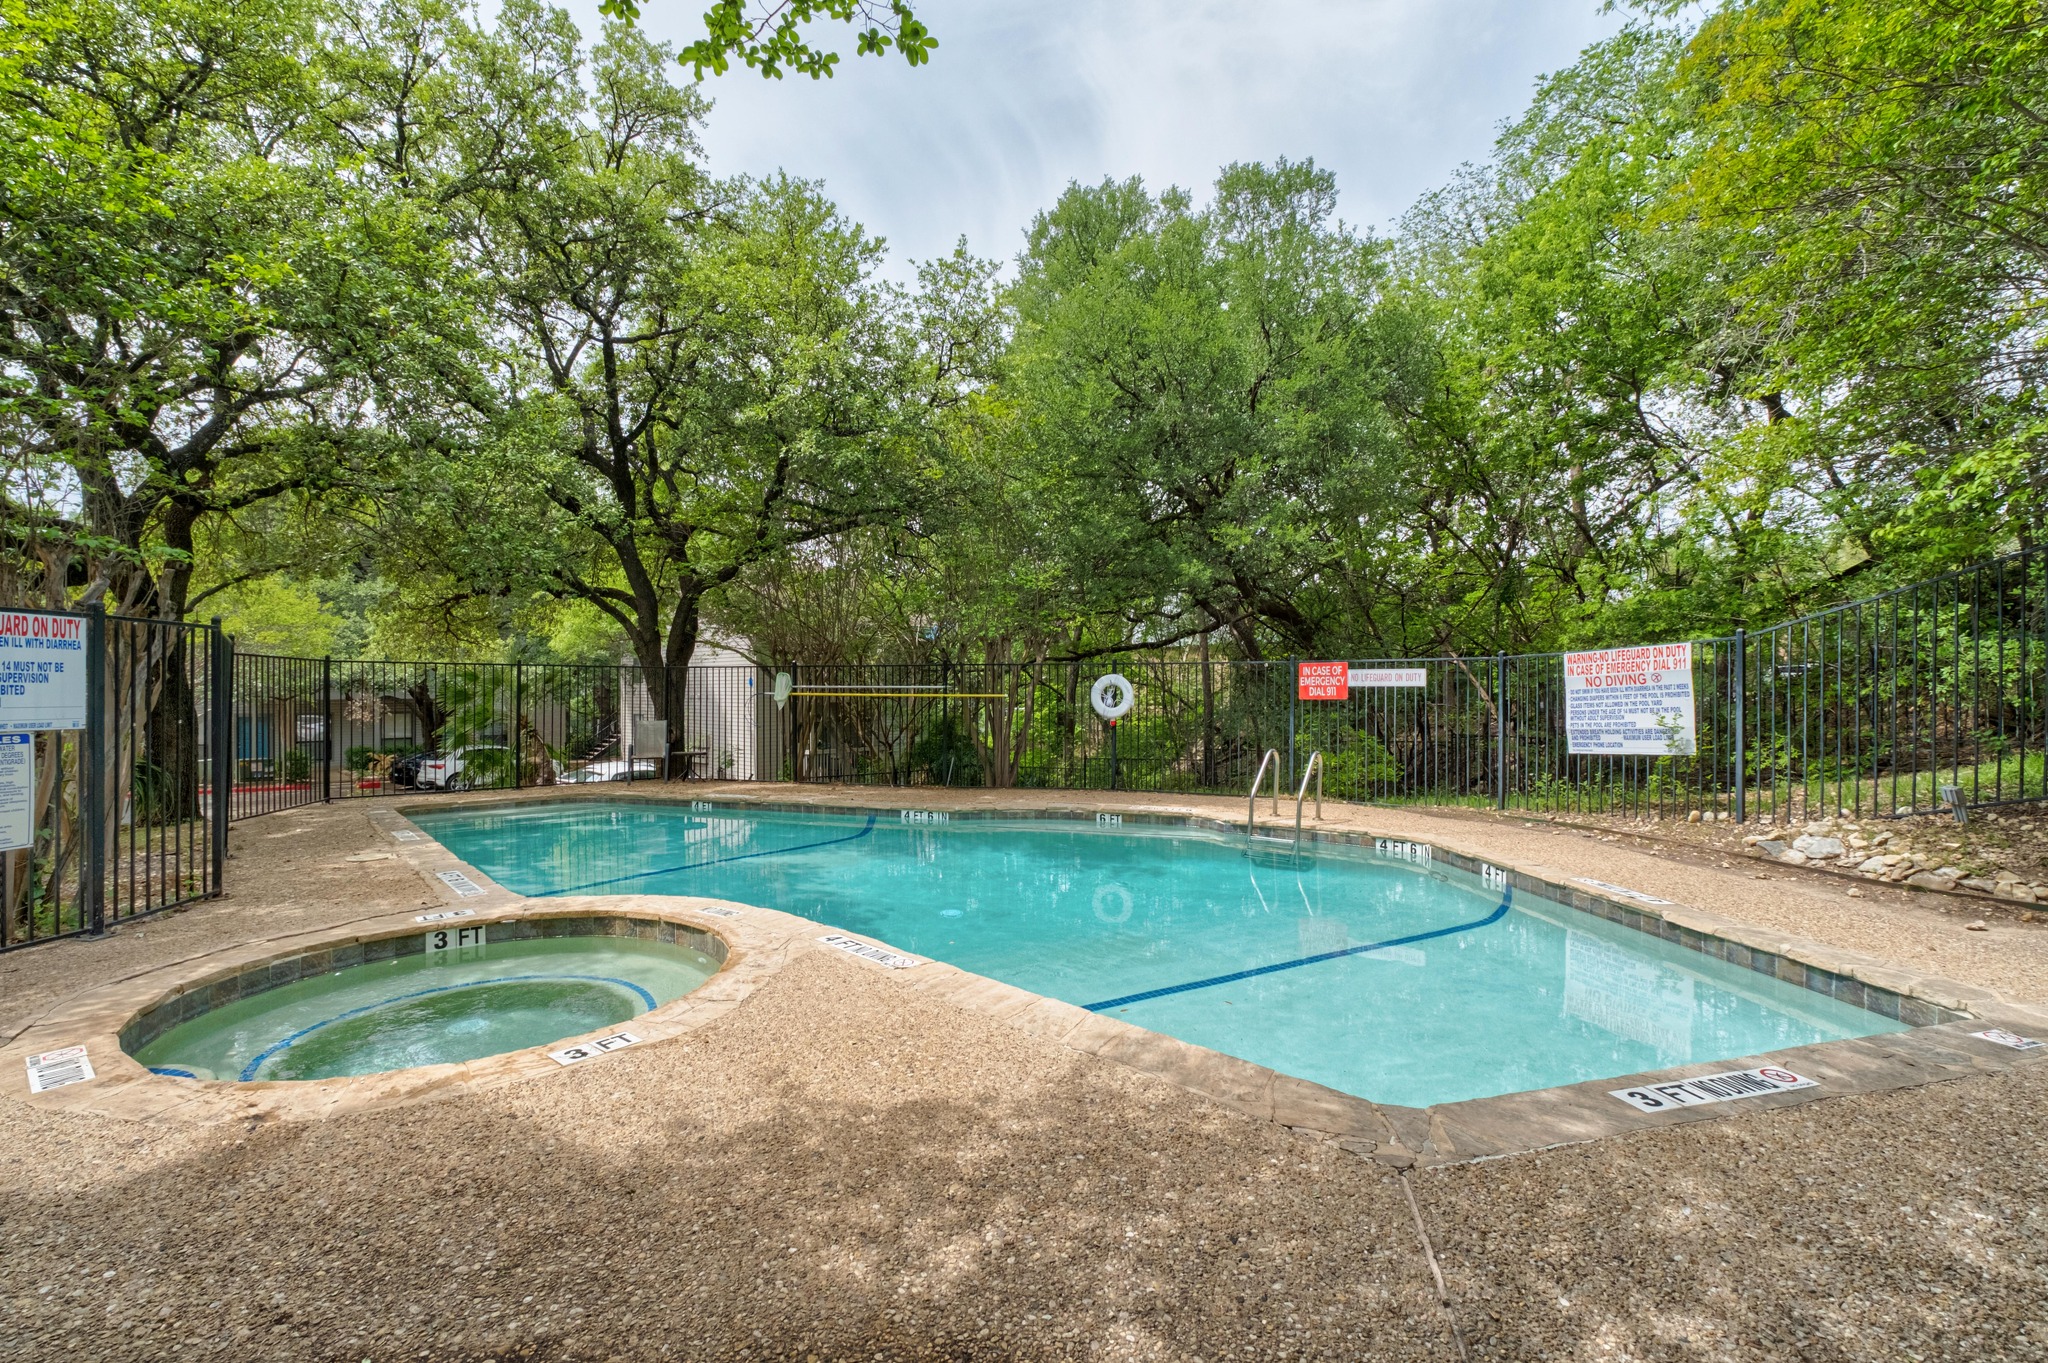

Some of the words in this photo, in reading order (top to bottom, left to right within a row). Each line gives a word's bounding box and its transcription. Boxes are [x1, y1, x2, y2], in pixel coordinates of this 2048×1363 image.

[33, 616, 48, 637] ON
[52, 618, 80, 638] DUTY
[12, 638, 22, 647] ILL
[25, 638, 43, 649] WITH
[46, 639, 81, 650] DIARRHEA
[1567, 652, 1609, 664] WARNING-NO
[1612, 648, 1650, 662] LIFEGUARD
[1653, 647, 1663, 658] ON
[1666, 645, 1686, 657] DUTY
[2, 661, 11, 671] 14
[14, 661, 34, 672] MUST
[38, 662, 52, 672] NOT
[55, 663, 64, 672] BE
[1303, 666, 1310, 675] IN
[1312, 666, 1330, 675] CASE
[1333, 666, 1342, 674] OF
[1568, 666, 1574, 676] IN
[1576, 664, 1593, 676] CASE
[1596, 664, 1604, 674] OF
[1606, 660, 1650, 674] EMERGENCY
[1654, 659, 1670, 670] DIAL
[1673, 658, 1686, 669] 911
[1301, 676, 1344, 686] EMERGENCY
[1406, 673, 1421, 681] DUTY
[1586, 676, 1602, 687] NO
[1606, 673, 1646, 686] DIVING
[1, 685, 25, 695] BITED
[1309, 687, 1325, 696] DIAL
[1327, 687, 1336, 695] 911
[1110, 814, 1120, 822] FT
[1380, 840, 1387, 849] 4
[1393, 841, 1405, 852] FT
[1411, 843, 1416, 854] 6
[1485, 865, 1491, 877] 4
[1496, 868, 1505, 882] FT
[434, 931, 448, 949] 3
[459, 926, 483, 946] FT
[834, 940, 862, 949] FT
[564, 1048, 588, 1059] 3
[596, 1033, 632, 1049] FT
[1687, 1080, 1732, 1097] NO
[1707, 1072, 1779, 1093] DIVING
[1627, 1091, 1664, 1107] 3
[1654, 1084, 1705, 1103] FT
